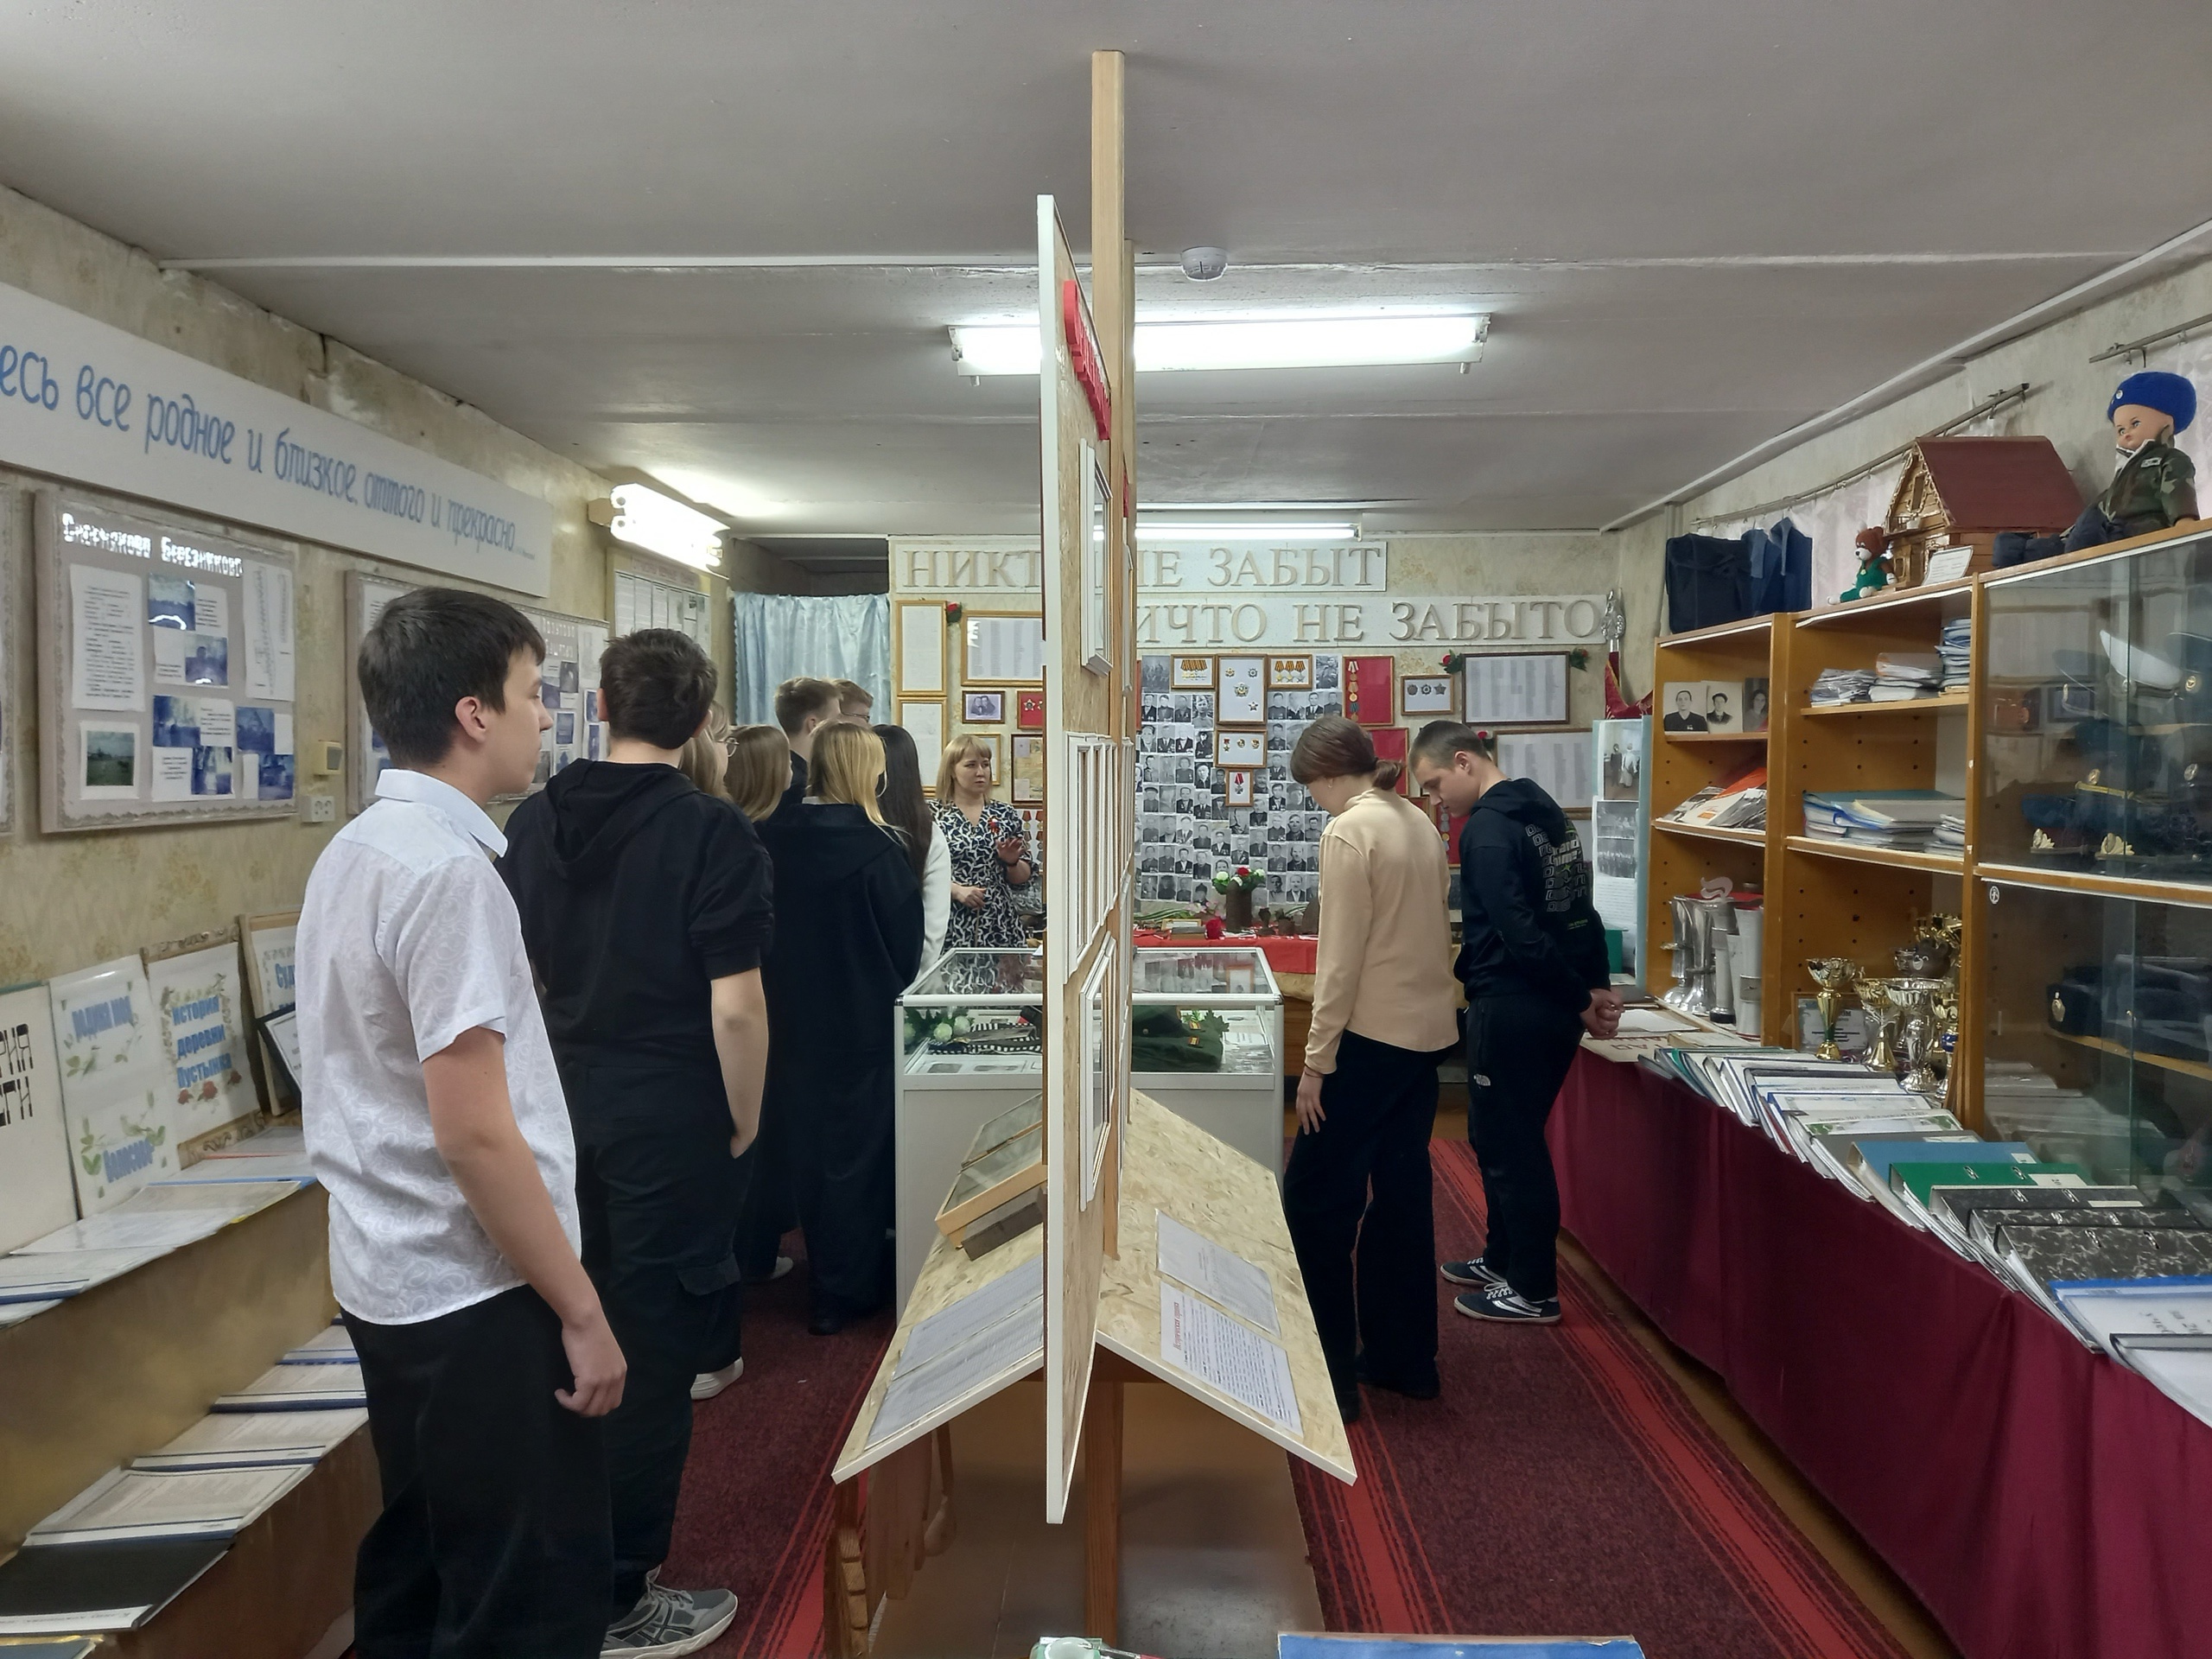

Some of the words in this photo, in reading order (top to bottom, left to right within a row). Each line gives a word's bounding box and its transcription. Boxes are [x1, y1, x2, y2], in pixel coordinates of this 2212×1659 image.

[0, 346, 60, 411] есь
[76, 365, 131, 432] все
[144, 393, 236, 465] родное
[247, 429, 263, 474] и
[365, 472, 426, 524] оттого
[431, 492, 442, 528] и
[903, 550, 1042, 588] НИКТ
[1207, 547, 1382, 588] ЗАБЫТ
[1137, 603, 1268, 643] ИЧТО
[1293, 603, 1364, 642] НЕ
[1389, 599, 1599, 641] ЗАБЫТО
